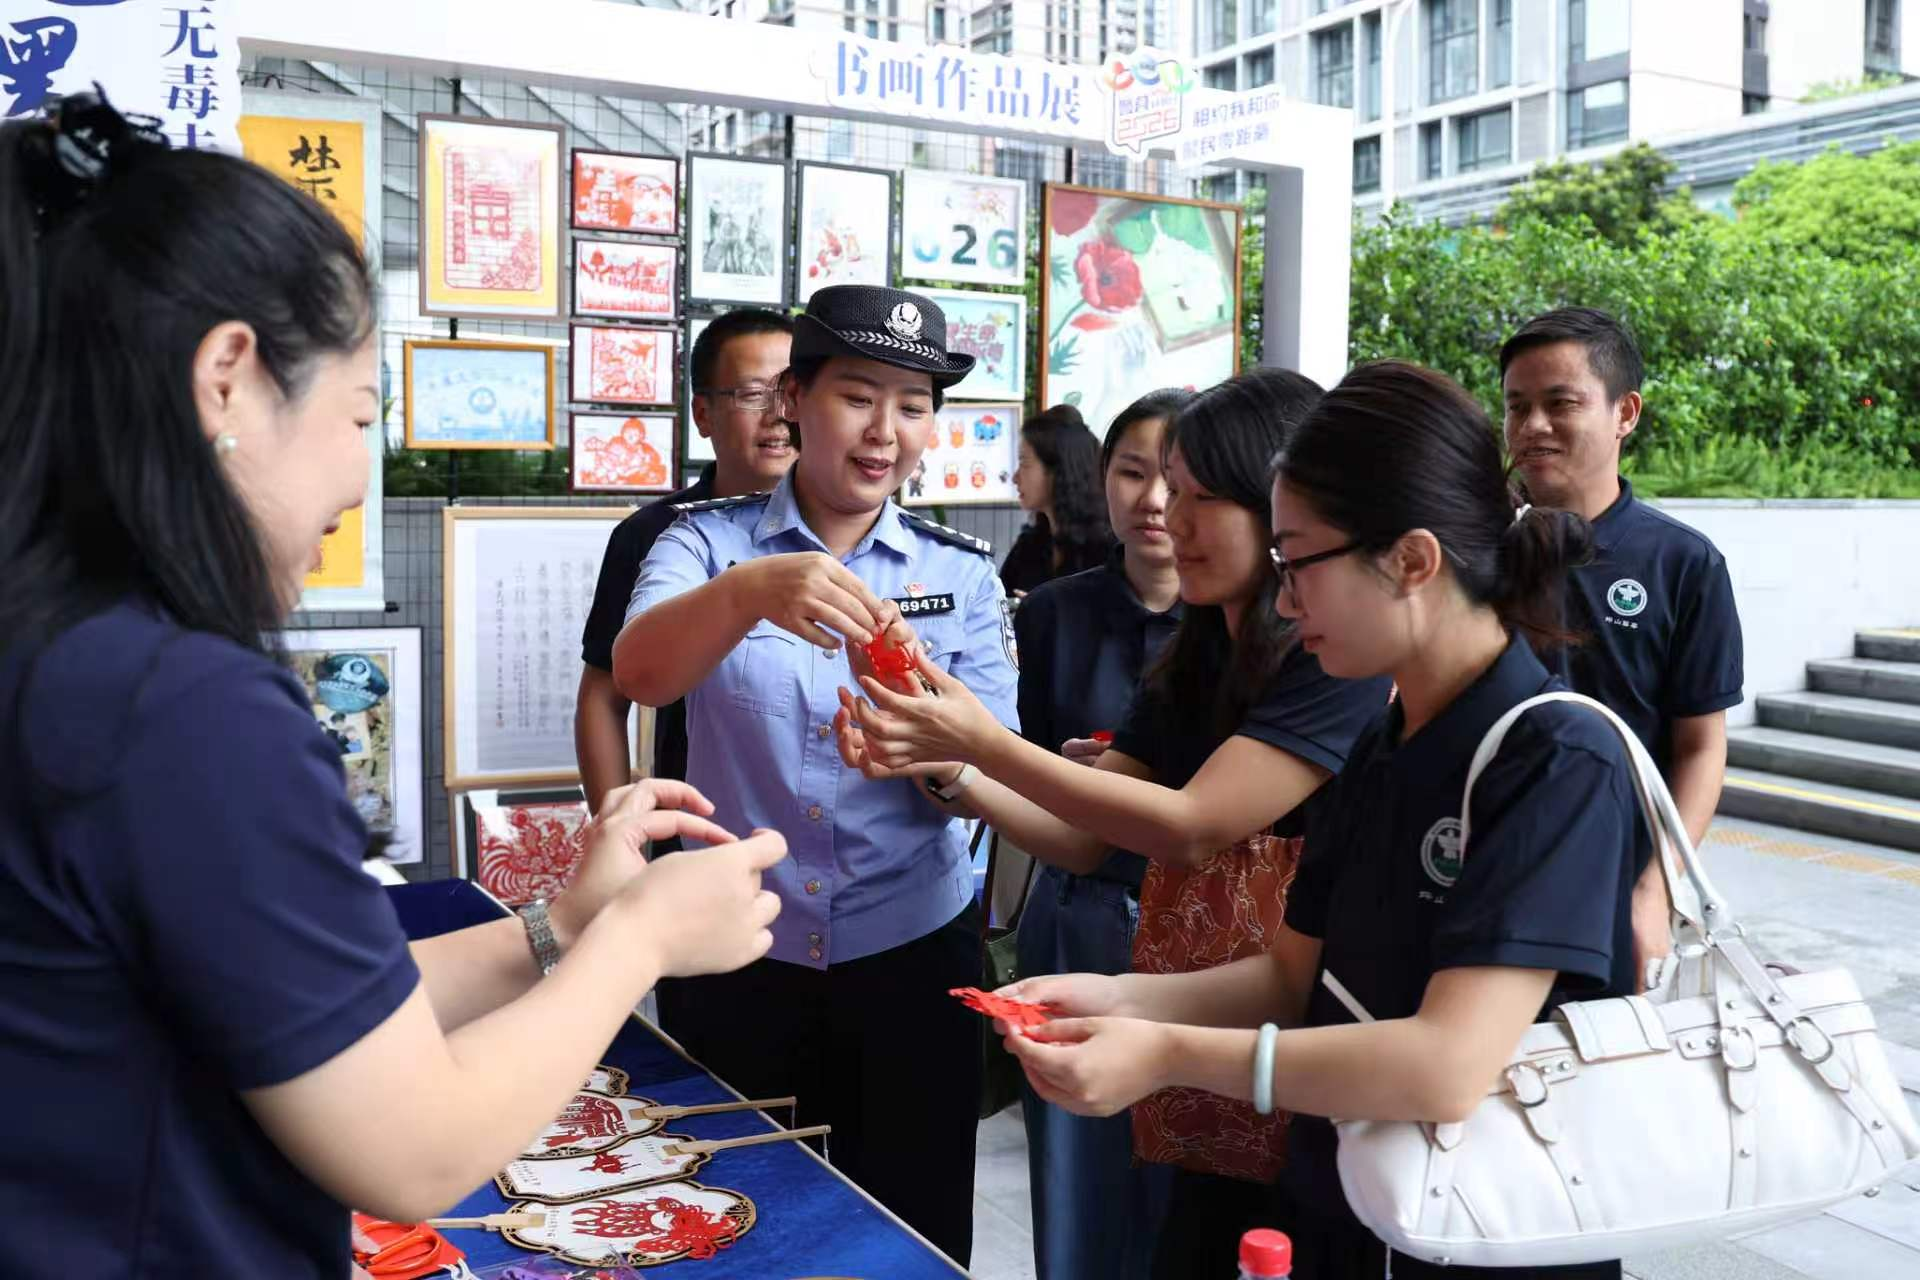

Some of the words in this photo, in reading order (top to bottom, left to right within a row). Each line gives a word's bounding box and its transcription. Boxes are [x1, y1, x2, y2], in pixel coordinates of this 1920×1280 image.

[837, 40, 1081, 125] 书画作品展
[900, 597, 950, 612] 69471
